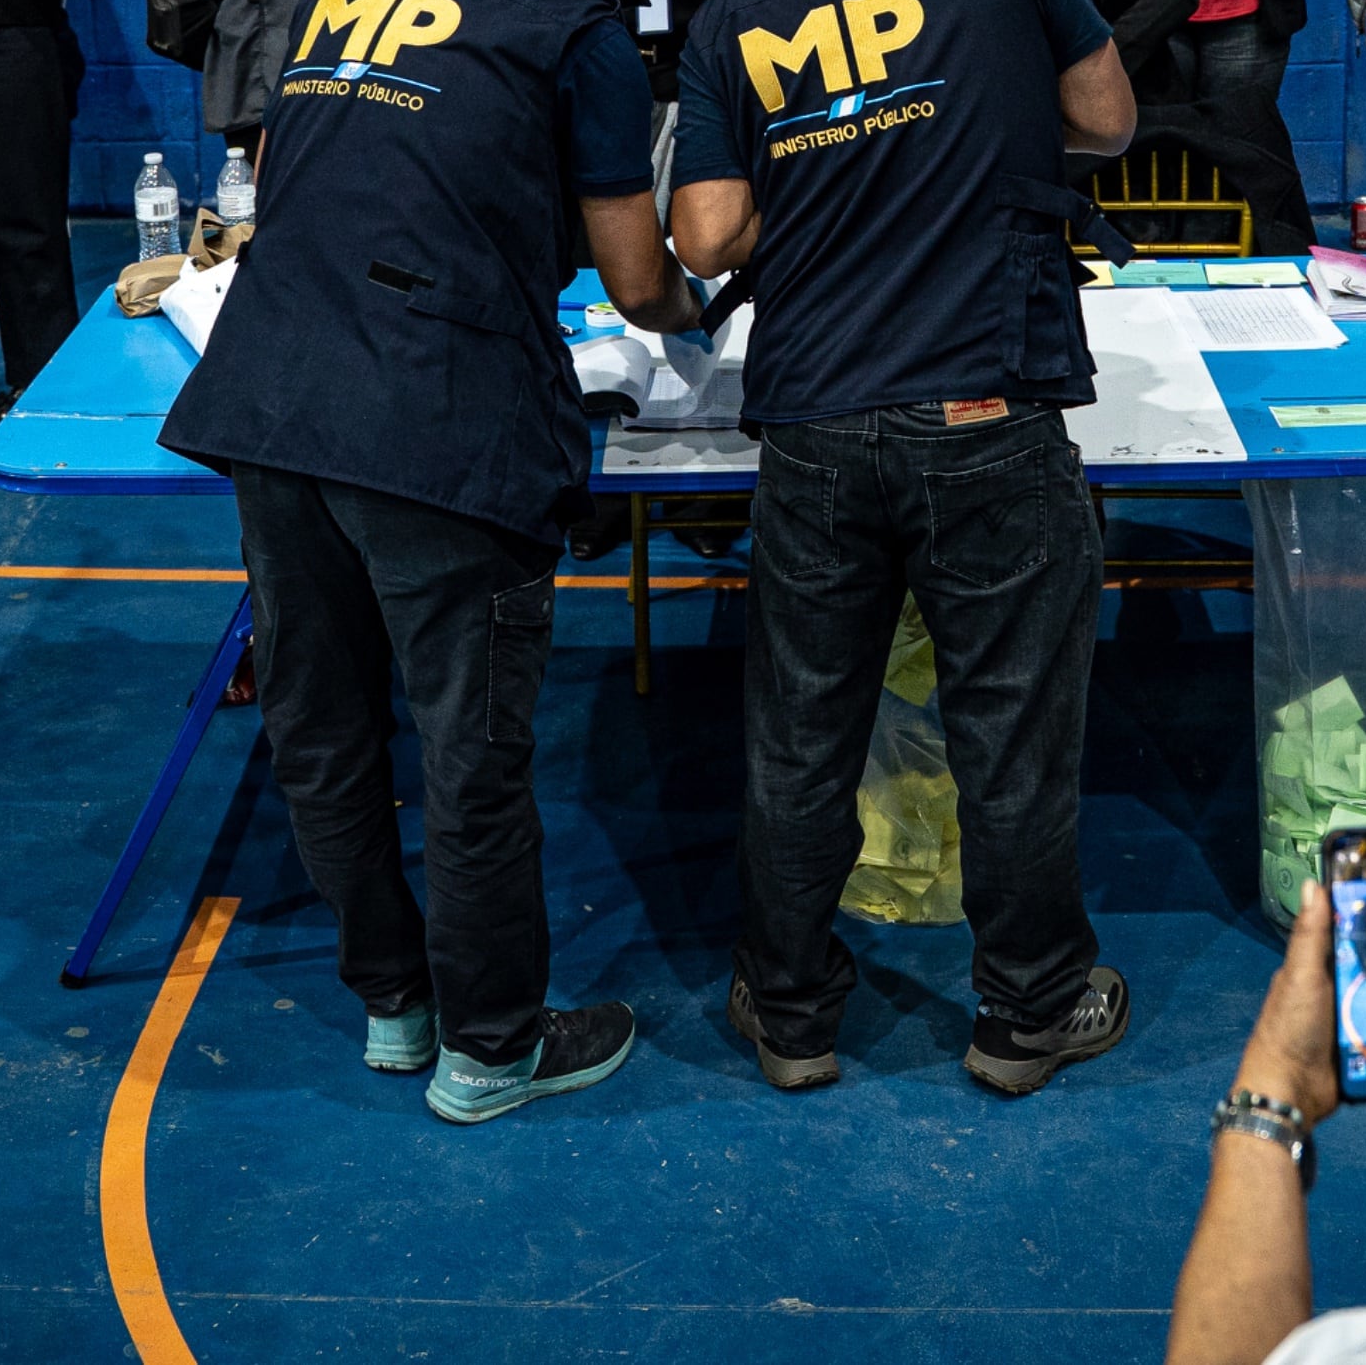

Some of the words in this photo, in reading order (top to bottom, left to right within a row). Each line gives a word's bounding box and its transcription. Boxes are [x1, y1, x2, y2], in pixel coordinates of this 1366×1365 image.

[282, 79, 350, 97] MINISTERIO
[357, 83, 424, 111] PÚBLICO
[864, 101, 935, 135] PÚBLICO
